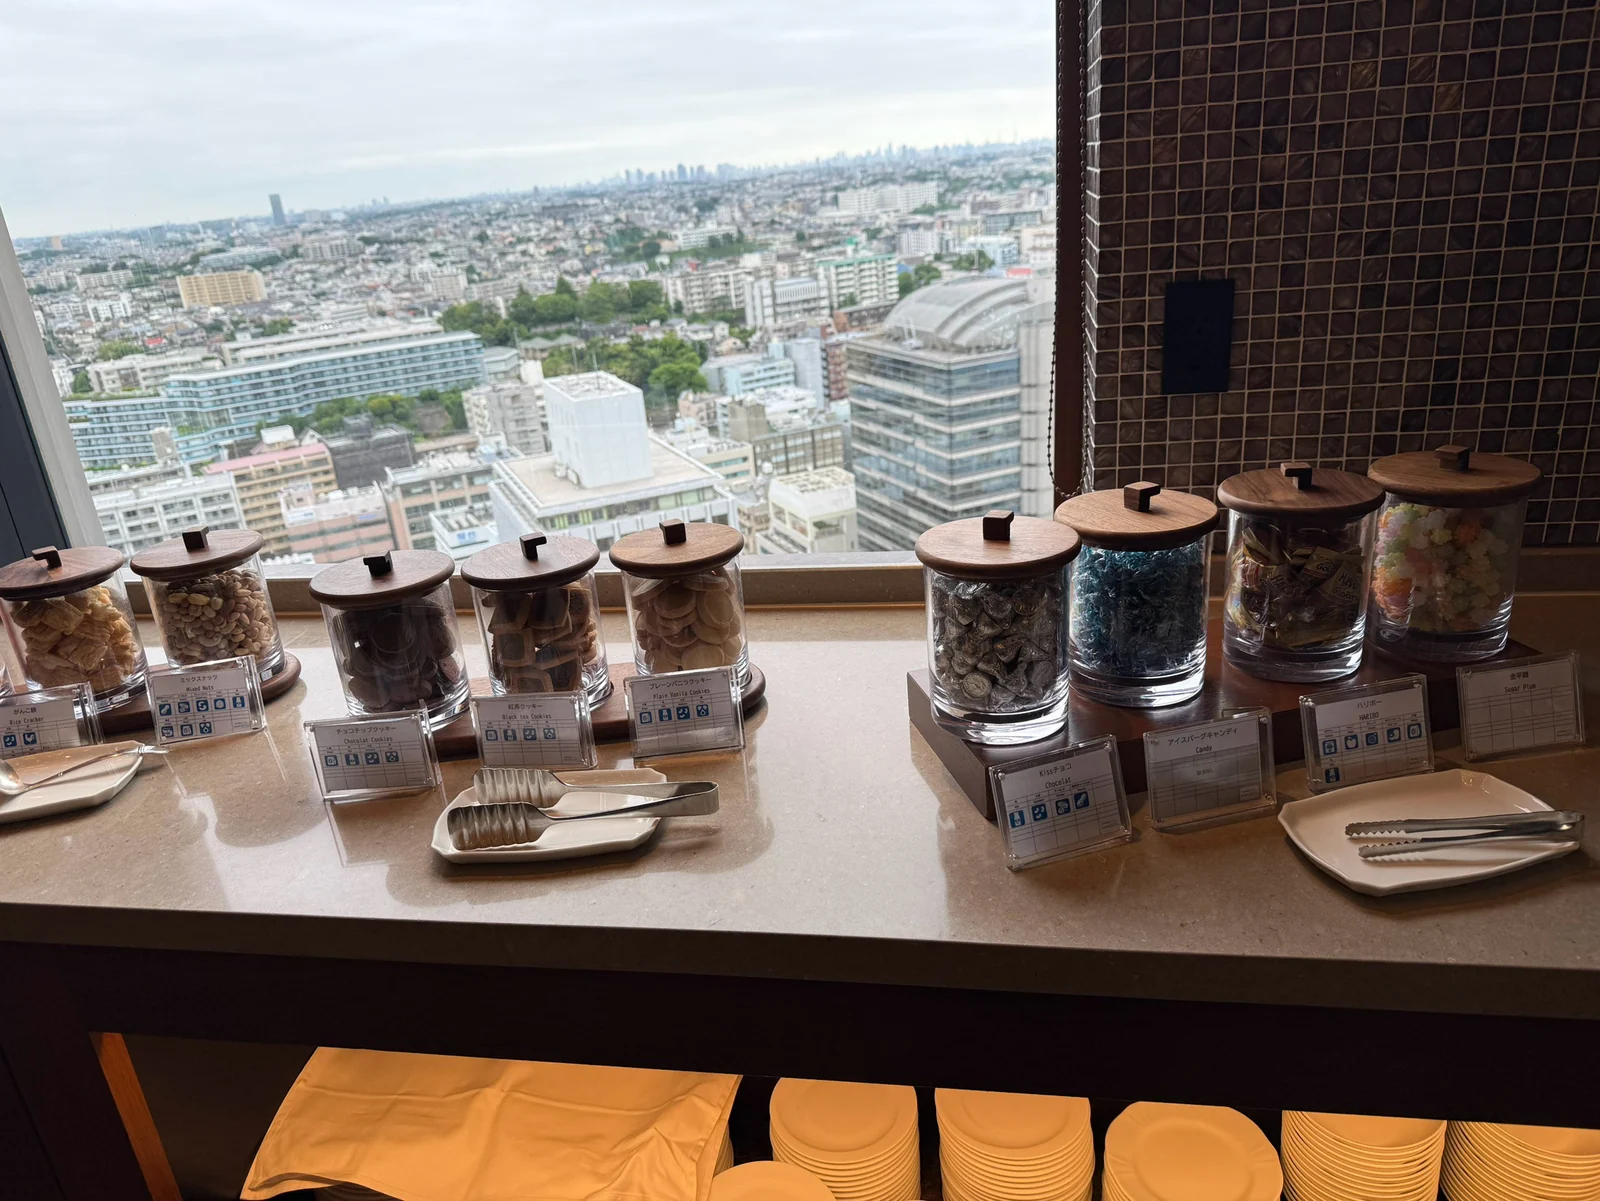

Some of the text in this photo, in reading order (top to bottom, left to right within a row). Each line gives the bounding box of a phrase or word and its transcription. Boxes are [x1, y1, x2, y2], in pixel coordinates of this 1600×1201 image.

[180, 674, 218, 683] ミックスナッツ
[649, 677, 712, 690] プレーンバニラクッキー
[689, 688, 711, 696] Cookies
[1504, 683, 1537, 694] Sugar Plum
[9, 716, 44, 726] Rice Cracker
[531, 712, 552, 720] Cookies
[1359, 711, 1380, 721] HARIBO
[336, 726, 397, 735] チョコチップクッキー
[344, 737, 368, 745] Chocolat
[1168, 727, 1238, 746] アイスバーグキャンディ
[1195, 745, 1213, 753] Candy
[1039, 762, 1072, 778] Kissチョコ
[1045, 777, 1072, 789] Chocolat
